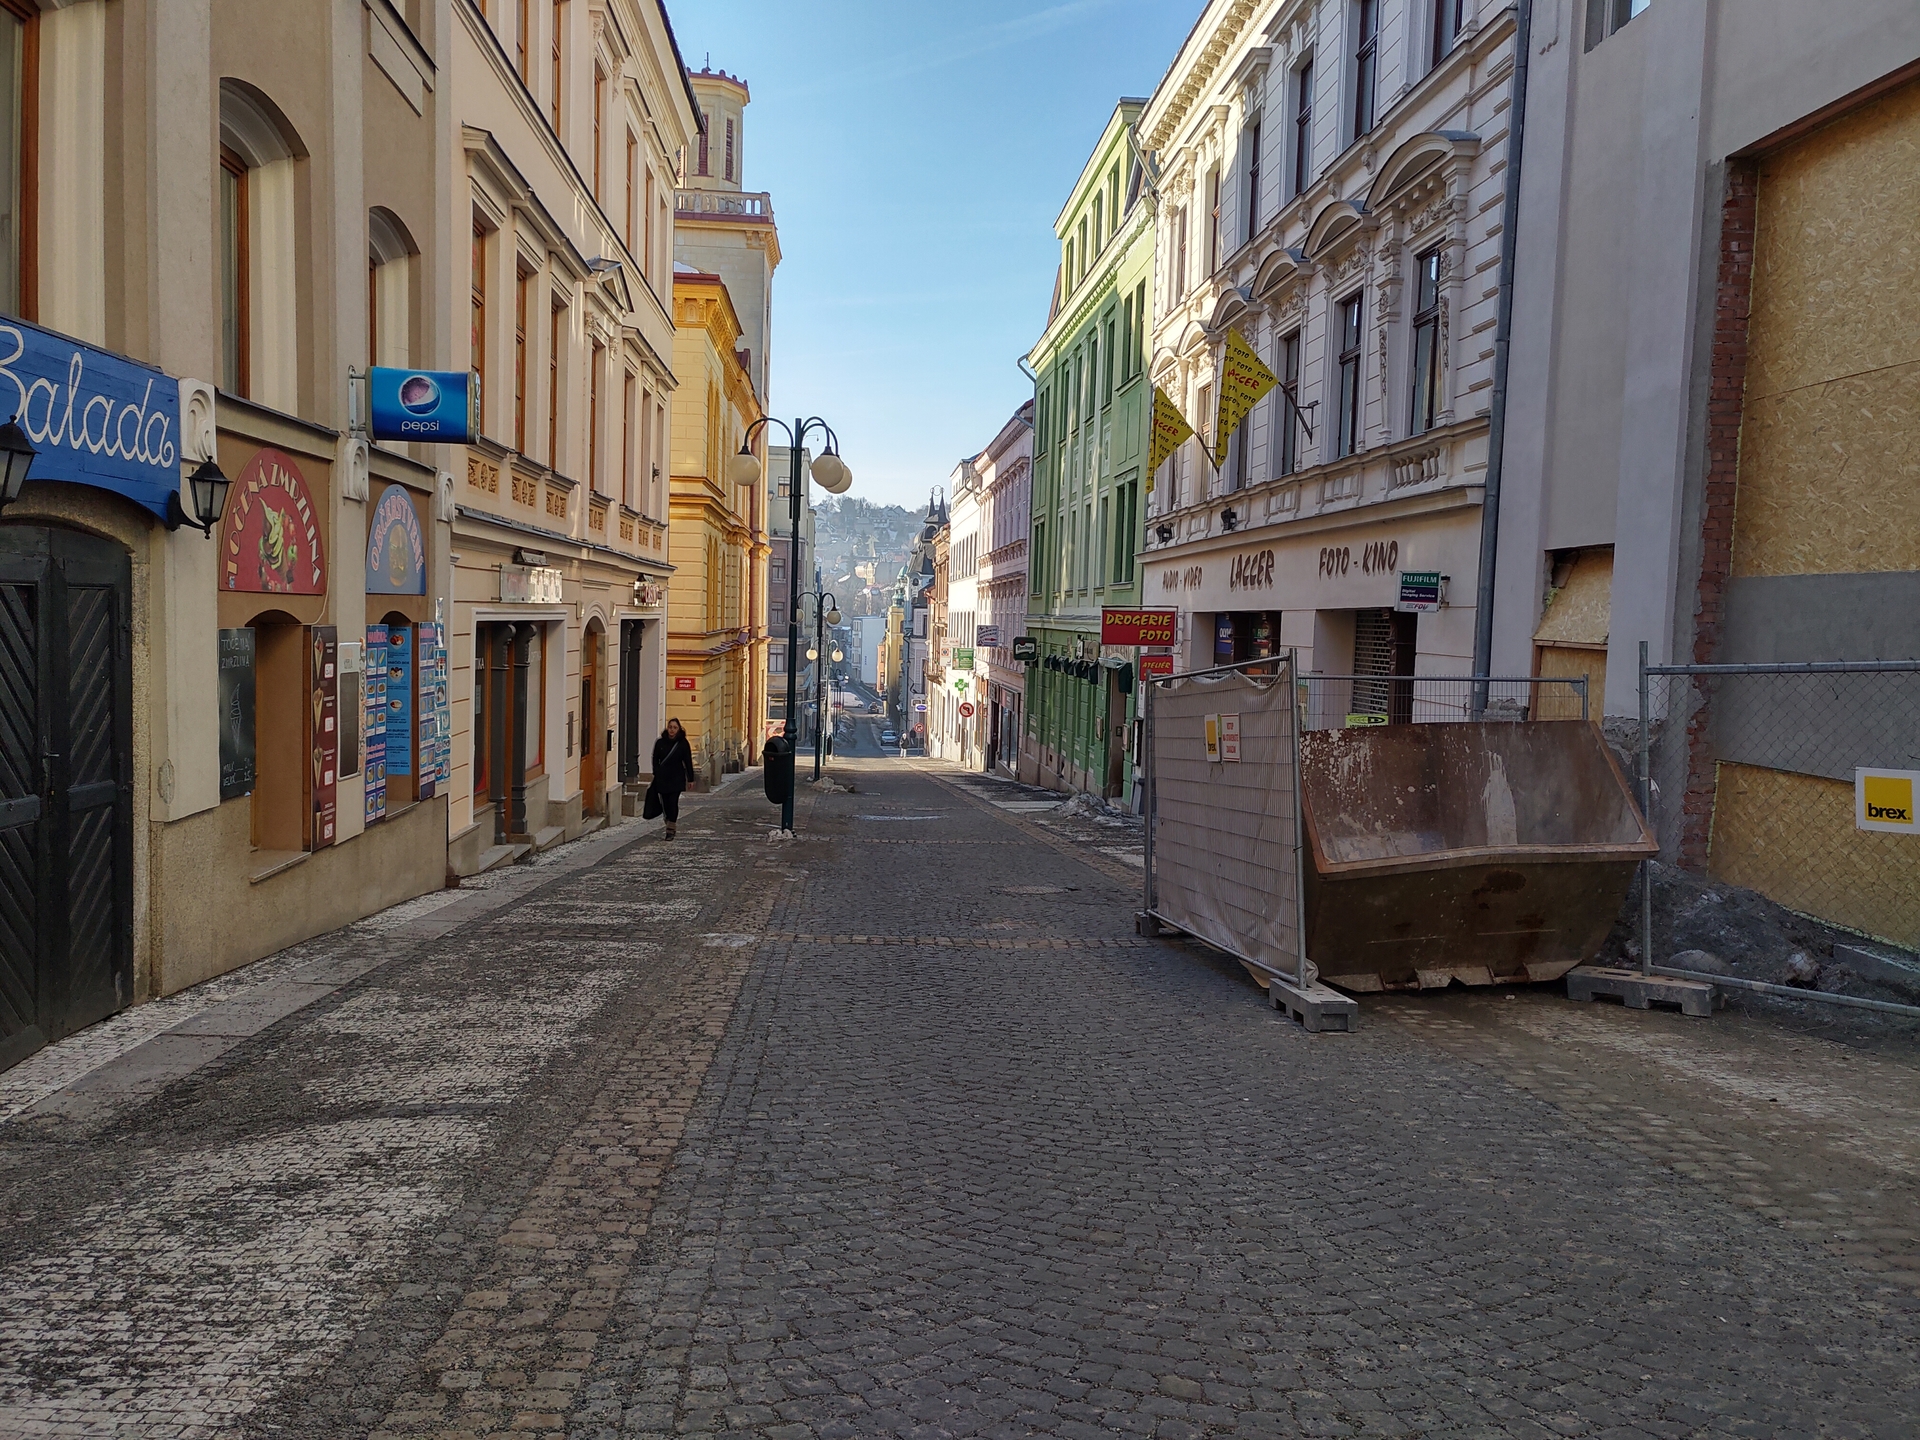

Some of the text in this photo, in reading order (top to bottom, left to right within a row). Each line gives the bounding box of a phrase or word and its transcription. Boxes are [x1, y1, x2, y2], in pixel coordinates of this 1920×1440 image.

[1234, 347, 1250, 359] FOTO
[1237, 361, 1274, 383] FOTO FOTO
[1240, 392, 1257, 404] FOTO
[1161, 401, 1174, 411] FOTO
[1161, 412, 1175, 422] FOTO
[401, 420, 440, 433] pepsi
[1158, 433, 1170, 443] FOTO
[1159, 444, 1171, 454] FOTO
[227, 459, 321, 587] TOČENÁ ZMRZLINA
[371, 495, 424, 574] OBČERSTVENÍ
[1319, 546, 1350, 580] FOTO
[1361, 540, 1399, 574] KINO
[1183, 565, 1203, 590] VIDEO
[1402, 575, 1437, 583] FUJIFILM
[1105, 613, 1172, 626] DROGERIE
[1139, 629, 1171, 641] FOTO
[1142, 661, 1171, 669] ATELIÉR
